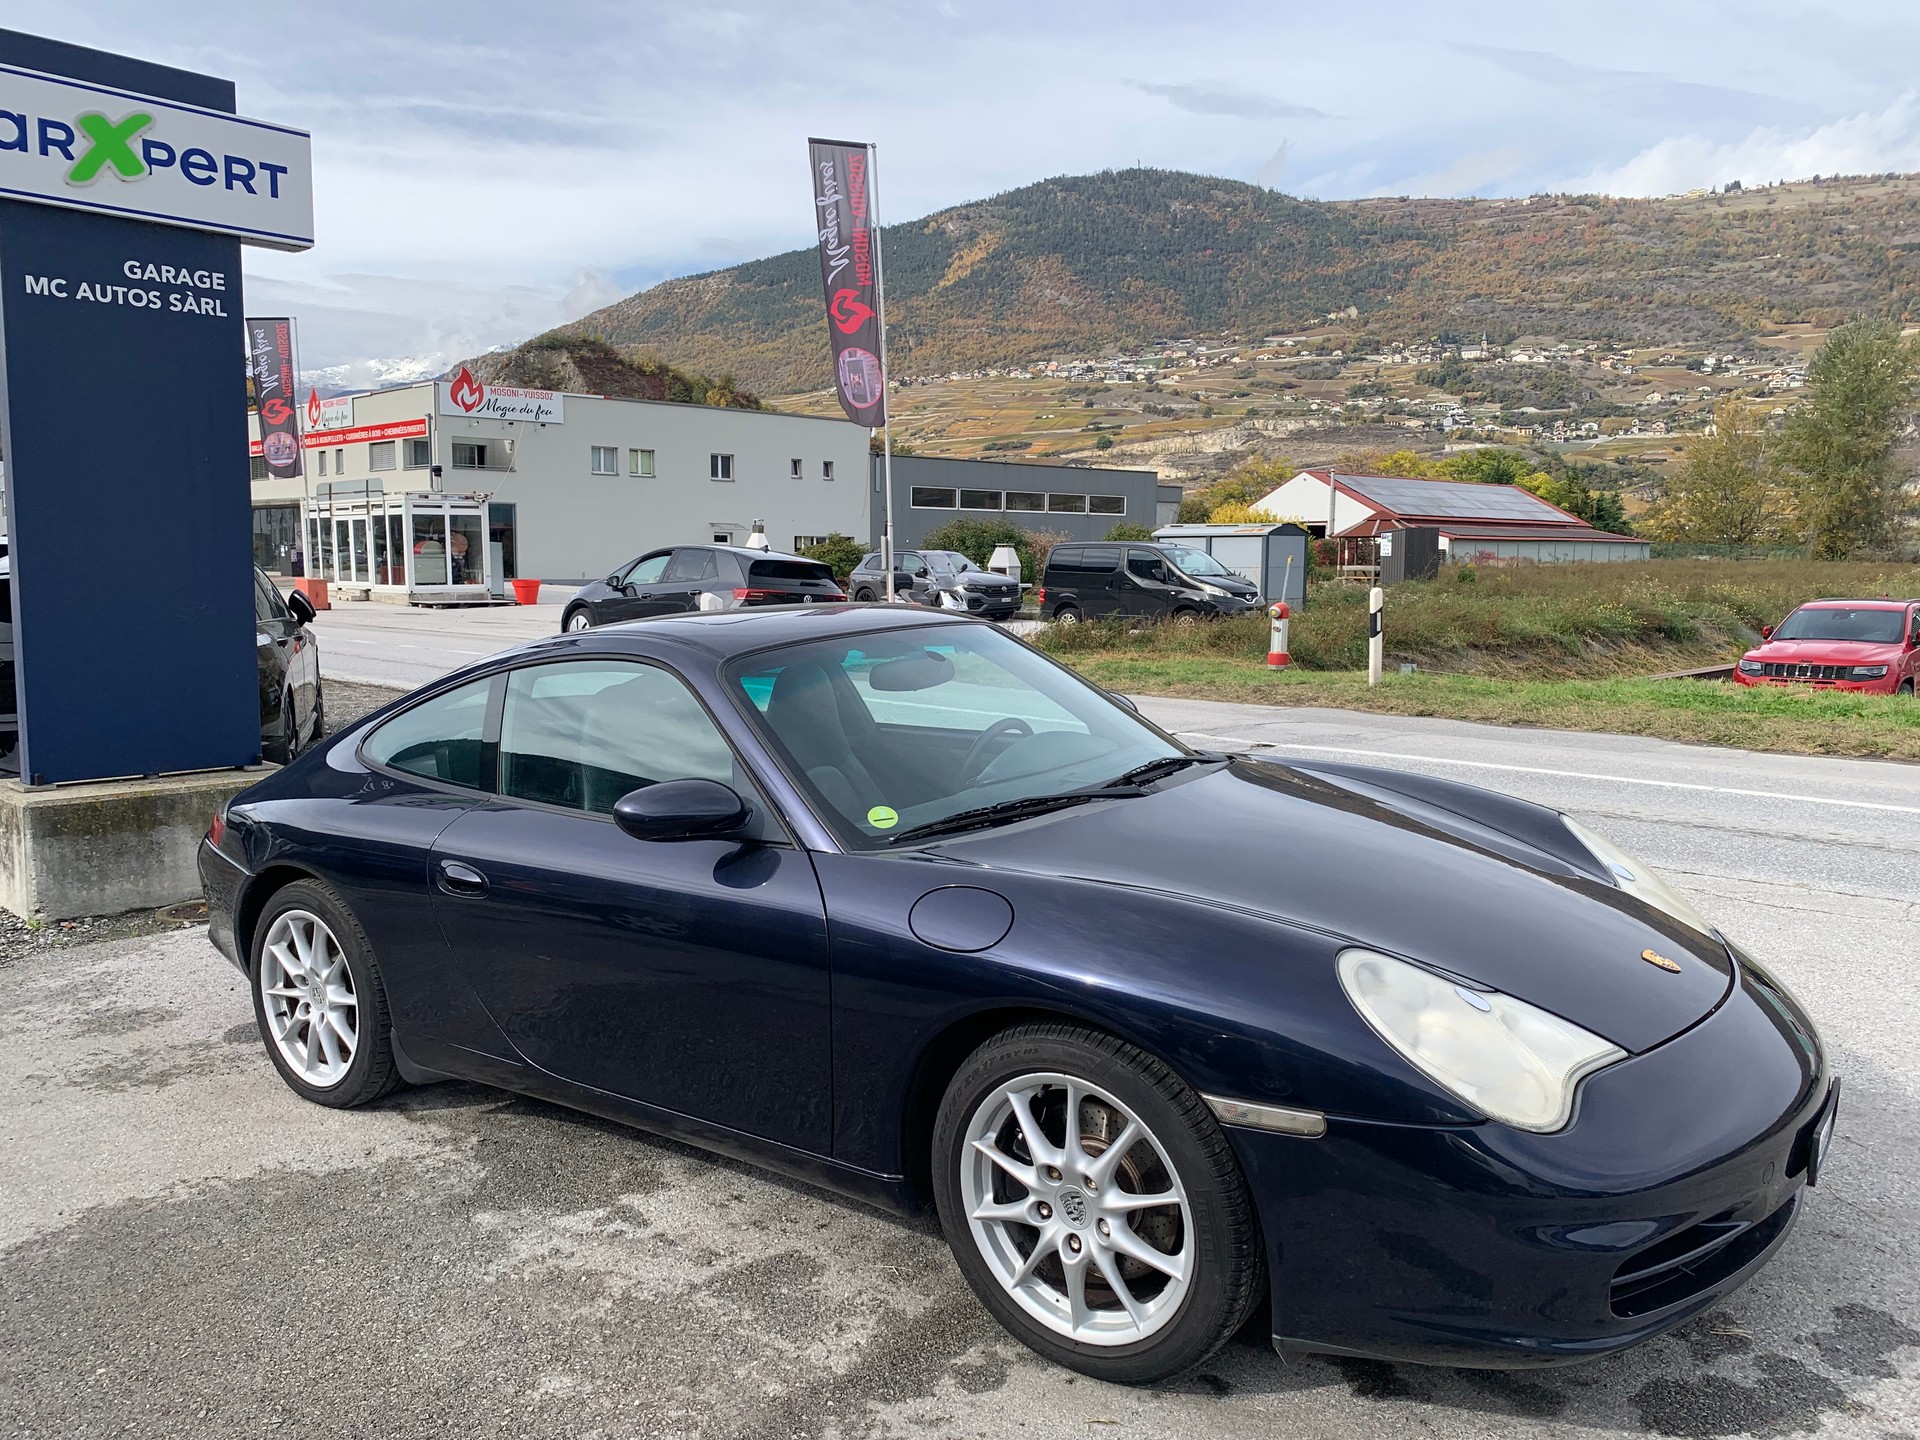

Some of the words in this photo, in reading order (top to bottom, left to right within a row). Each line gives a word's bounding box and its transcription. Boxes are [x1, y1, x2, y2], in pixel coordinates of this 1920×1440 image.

[123, 260, 226, 291] GARAGE
[25, 274, 68, 299] MC
[76, 282, 162, 310] AUTOS
[169, 290, 228, 318] SÀRL
[490, 387, 553, 400] MOSONI-VUISSOZ
[476, 397, 518, 419] Magie
[519, 402, 534, 415] du
[535, 404, 554, 421] feu
